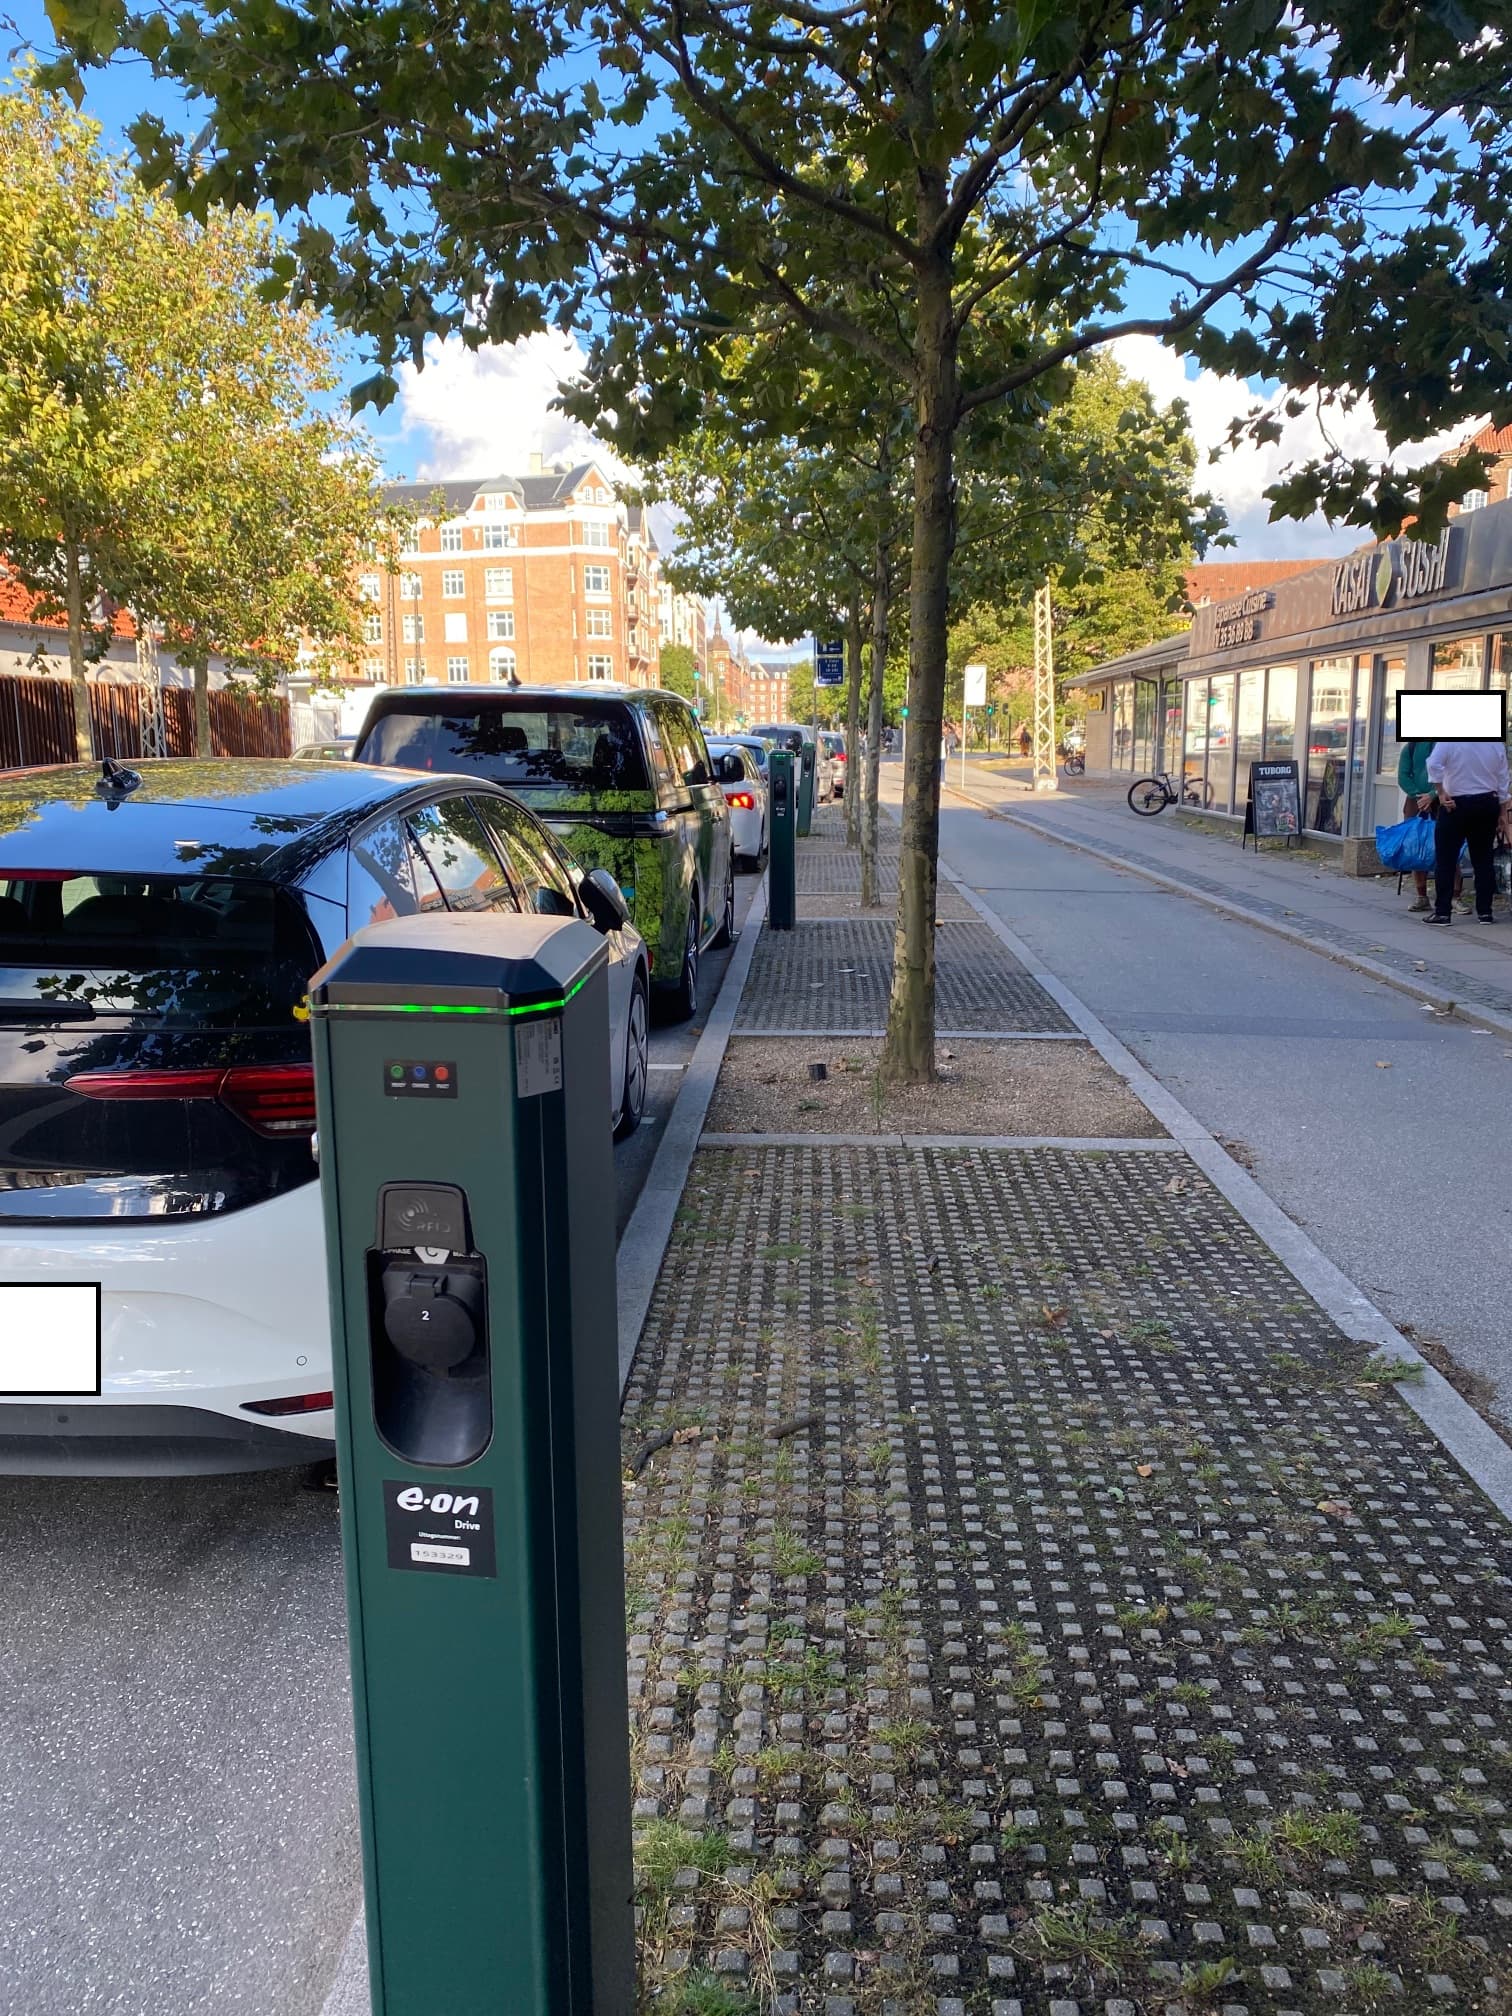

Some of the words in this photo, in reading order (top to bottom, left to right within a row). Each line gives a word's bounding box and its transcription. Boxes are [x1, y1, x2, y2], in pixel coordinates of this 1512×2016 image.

[1332, 556, 1373, 615] KASAI
[1396, 527, 1450, 600] SUSHI
[1259, 766, 1291, 775] TUBORG
[422, 1310, 430, 1321] 2
[454, 1520, 480, 1531] Drive
